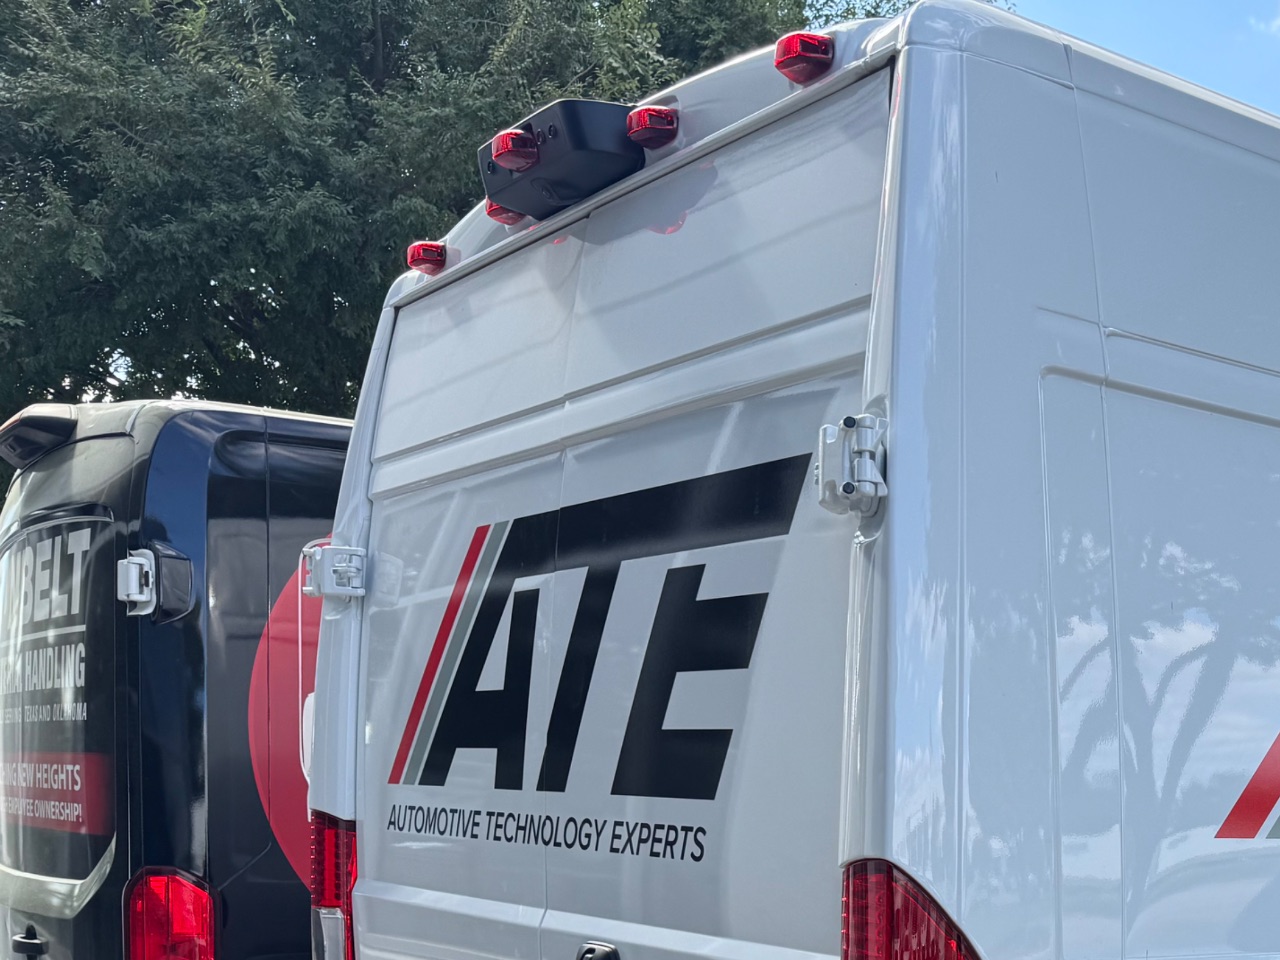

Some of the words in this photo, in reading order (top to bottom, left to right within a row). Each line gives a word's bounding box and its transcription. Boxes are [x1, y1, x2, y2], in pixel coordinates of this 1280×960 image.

[418, 452, 813, 801] ATE
[25, 642, 86, 692] HANDLING
[39, 704, 51, 721] AND
[52, 702, 87, 721] OKLAHOMA
[17, 763, 34, 788] NEW
[35, 763, 82, 791] HEIGHTS
[34, 799, 83, 823] OWNERSHIP!
[386, 804, 482, 840] AUTOMOTIVE
[486, 810, 607, 852] TECHNOLOGY
[609, 820, 707, 863] EXPERTS
